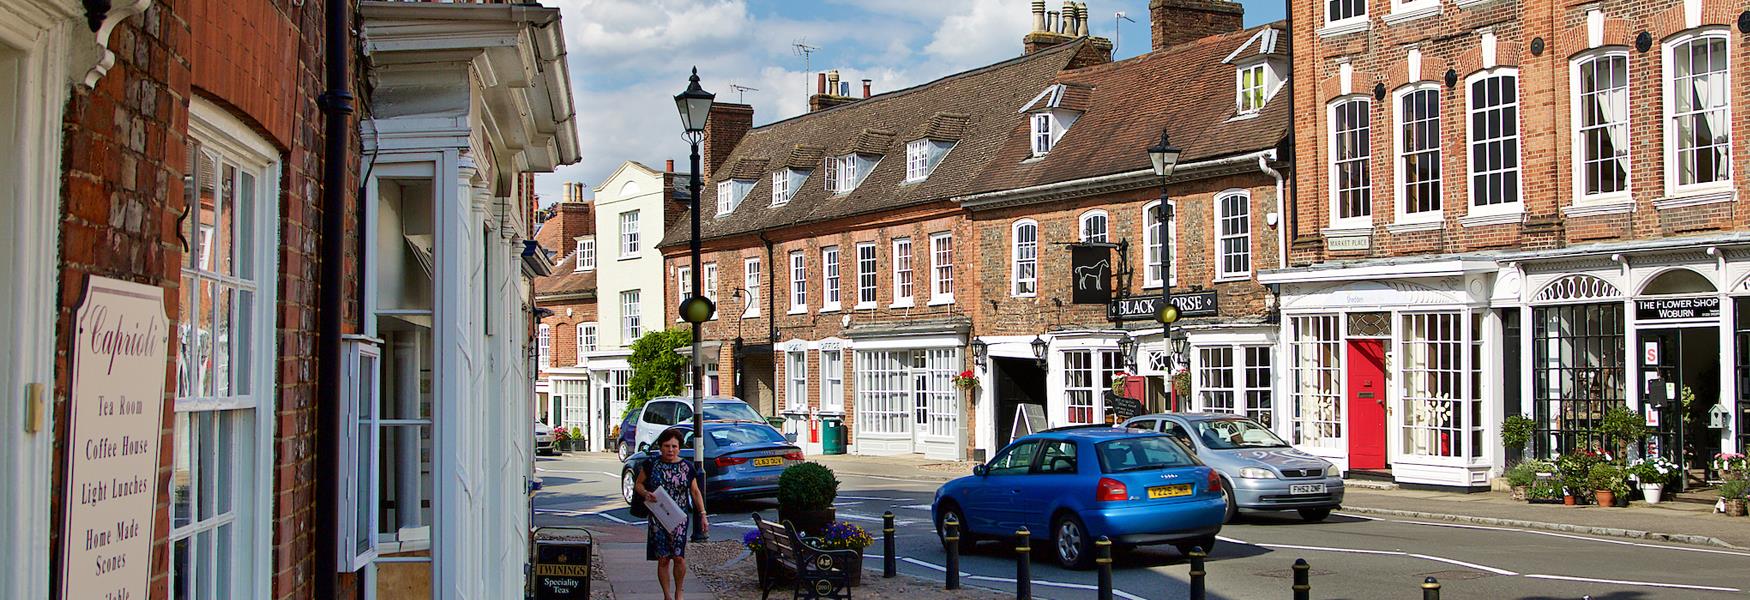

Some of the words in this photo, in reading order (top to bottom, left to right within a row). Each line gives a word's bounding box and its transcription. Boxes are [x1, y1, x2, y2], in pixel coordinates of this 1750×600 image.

[1352, 239, 1367, 247] PLACE
[1120, 299, 1155, 315] BLACK
[1161, 295, 1203, 313] ORSE
[1639, 301, 1655, 310] THE
[1656, 300, 1692, 309] FLOWER
[1693, 299, 1719, 308] SHOP
[1658, 309, 1695, 318] WOBURN
[90, 304, 158, 375] Caprioli
[98, 395, 114, 416] Tea
[119, 395, 143, 416] Room
[85, 437, 118, 461] Coffee
[122, 436, 148, 456] House
[81, 482, 107, 507] Light
[112, 475, 148, 499] Lunches
[86, 528, 112, 551] Home
[116, 519, 139, 542] Made
[96, 553, 127, 576] Scones
[540, 565, 585, 575] TWININGS
[544, 577, 579, 588] Speciality
[552, 586, 570, 594] Teas
